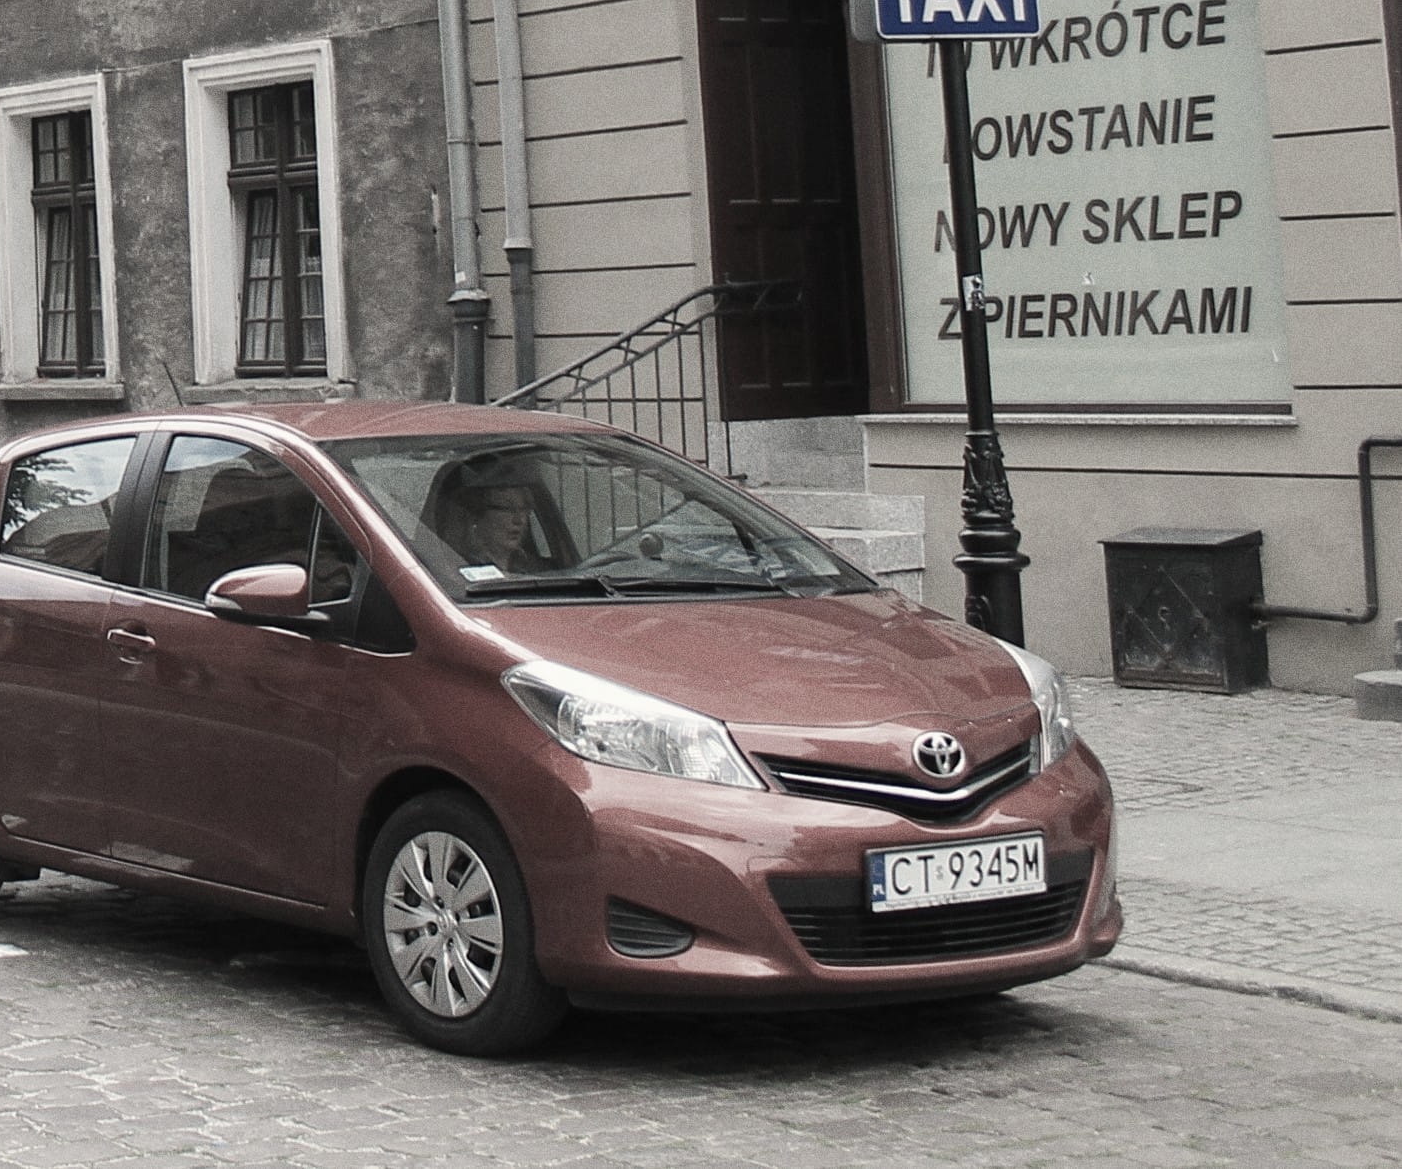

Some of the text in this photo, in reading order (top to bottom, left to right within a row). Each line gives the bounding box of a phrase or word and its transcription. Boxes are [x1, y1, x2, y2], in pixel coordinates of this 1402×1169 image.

[989, 0, 1227, 71] WKRÓTCE
[943, 95, 1215, 165] OWSTANIE
[1082, 190, 1243, 245] SKLEP
[891, 841, 1041, 896] CT 9345M
